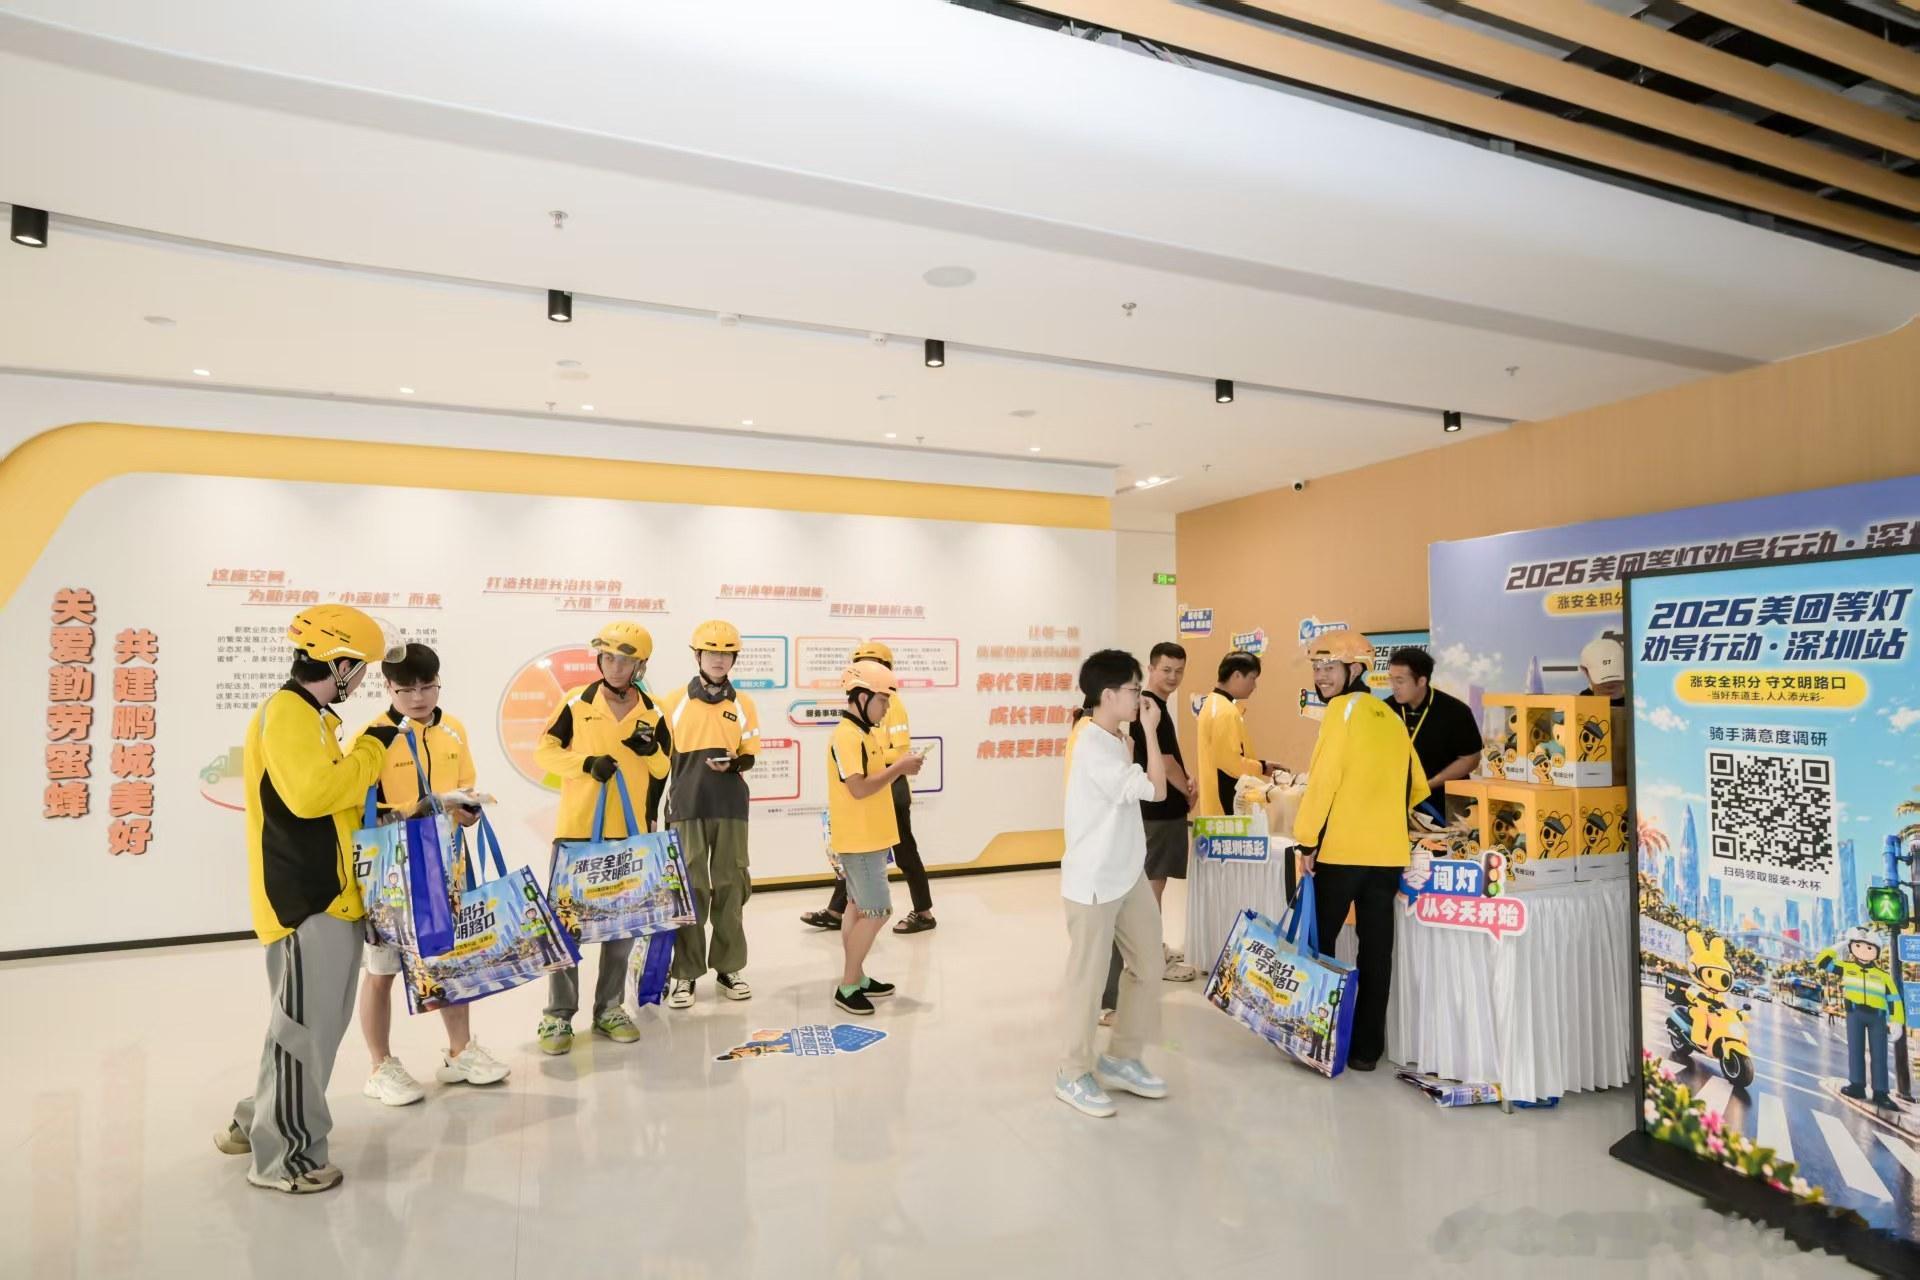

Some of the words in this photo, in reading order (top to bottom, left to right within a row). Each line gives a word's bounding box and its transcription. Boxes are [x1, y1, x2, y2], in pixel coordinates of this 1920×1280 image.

[1506, 520, 1920, 590] 2026美团等灯劝导行动·深
[1648, 588, 1913, 629] 2026美团等灯
[1640, 627, 1908, 662] 劝导行动·深圳站
[1690, 675, 1761, 689] 涨安全积分
[1765, 675, 1846, 690] 守文明路口
[44, 587, 96, 819] 关爱勤劳蜜蜂
[108, 628, 159, 855] 共建鹏城美好
[1709, 726, 1828, 747] 骑手满意度调研
[586, 858, 643, 884] 守文明路口
[1723, 865, 1822, 891] 扫码领取服装+水杯
[1421, 898, 1520, 927] 从今天开始
